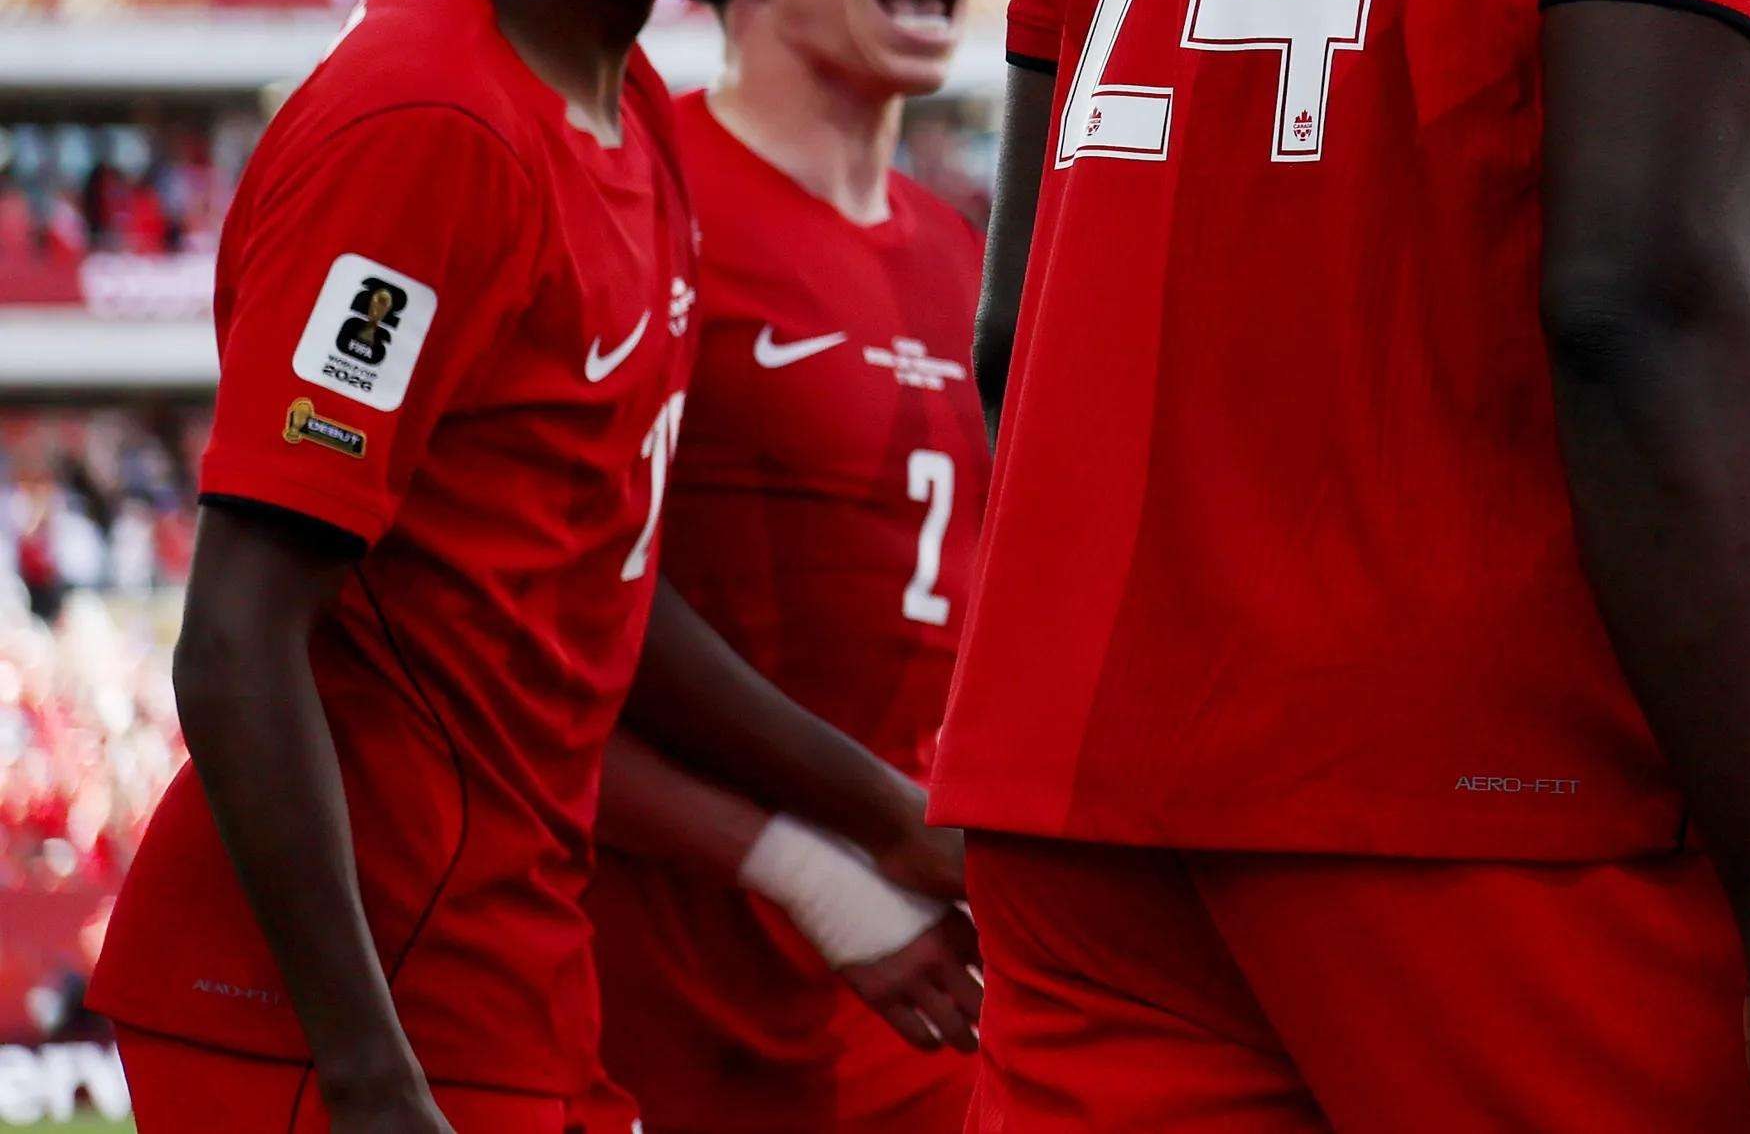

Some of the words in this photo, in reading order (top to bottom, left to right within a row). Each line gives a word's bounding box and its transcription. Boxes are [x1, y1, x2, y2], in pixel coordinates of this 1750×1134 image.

[322, 364, 375, 393] 2026
[307, 418, 361, 446] DEBUT
[903, 448, 955, 626] 2
[1454, 775, 1580, 795] AERO-FIT
